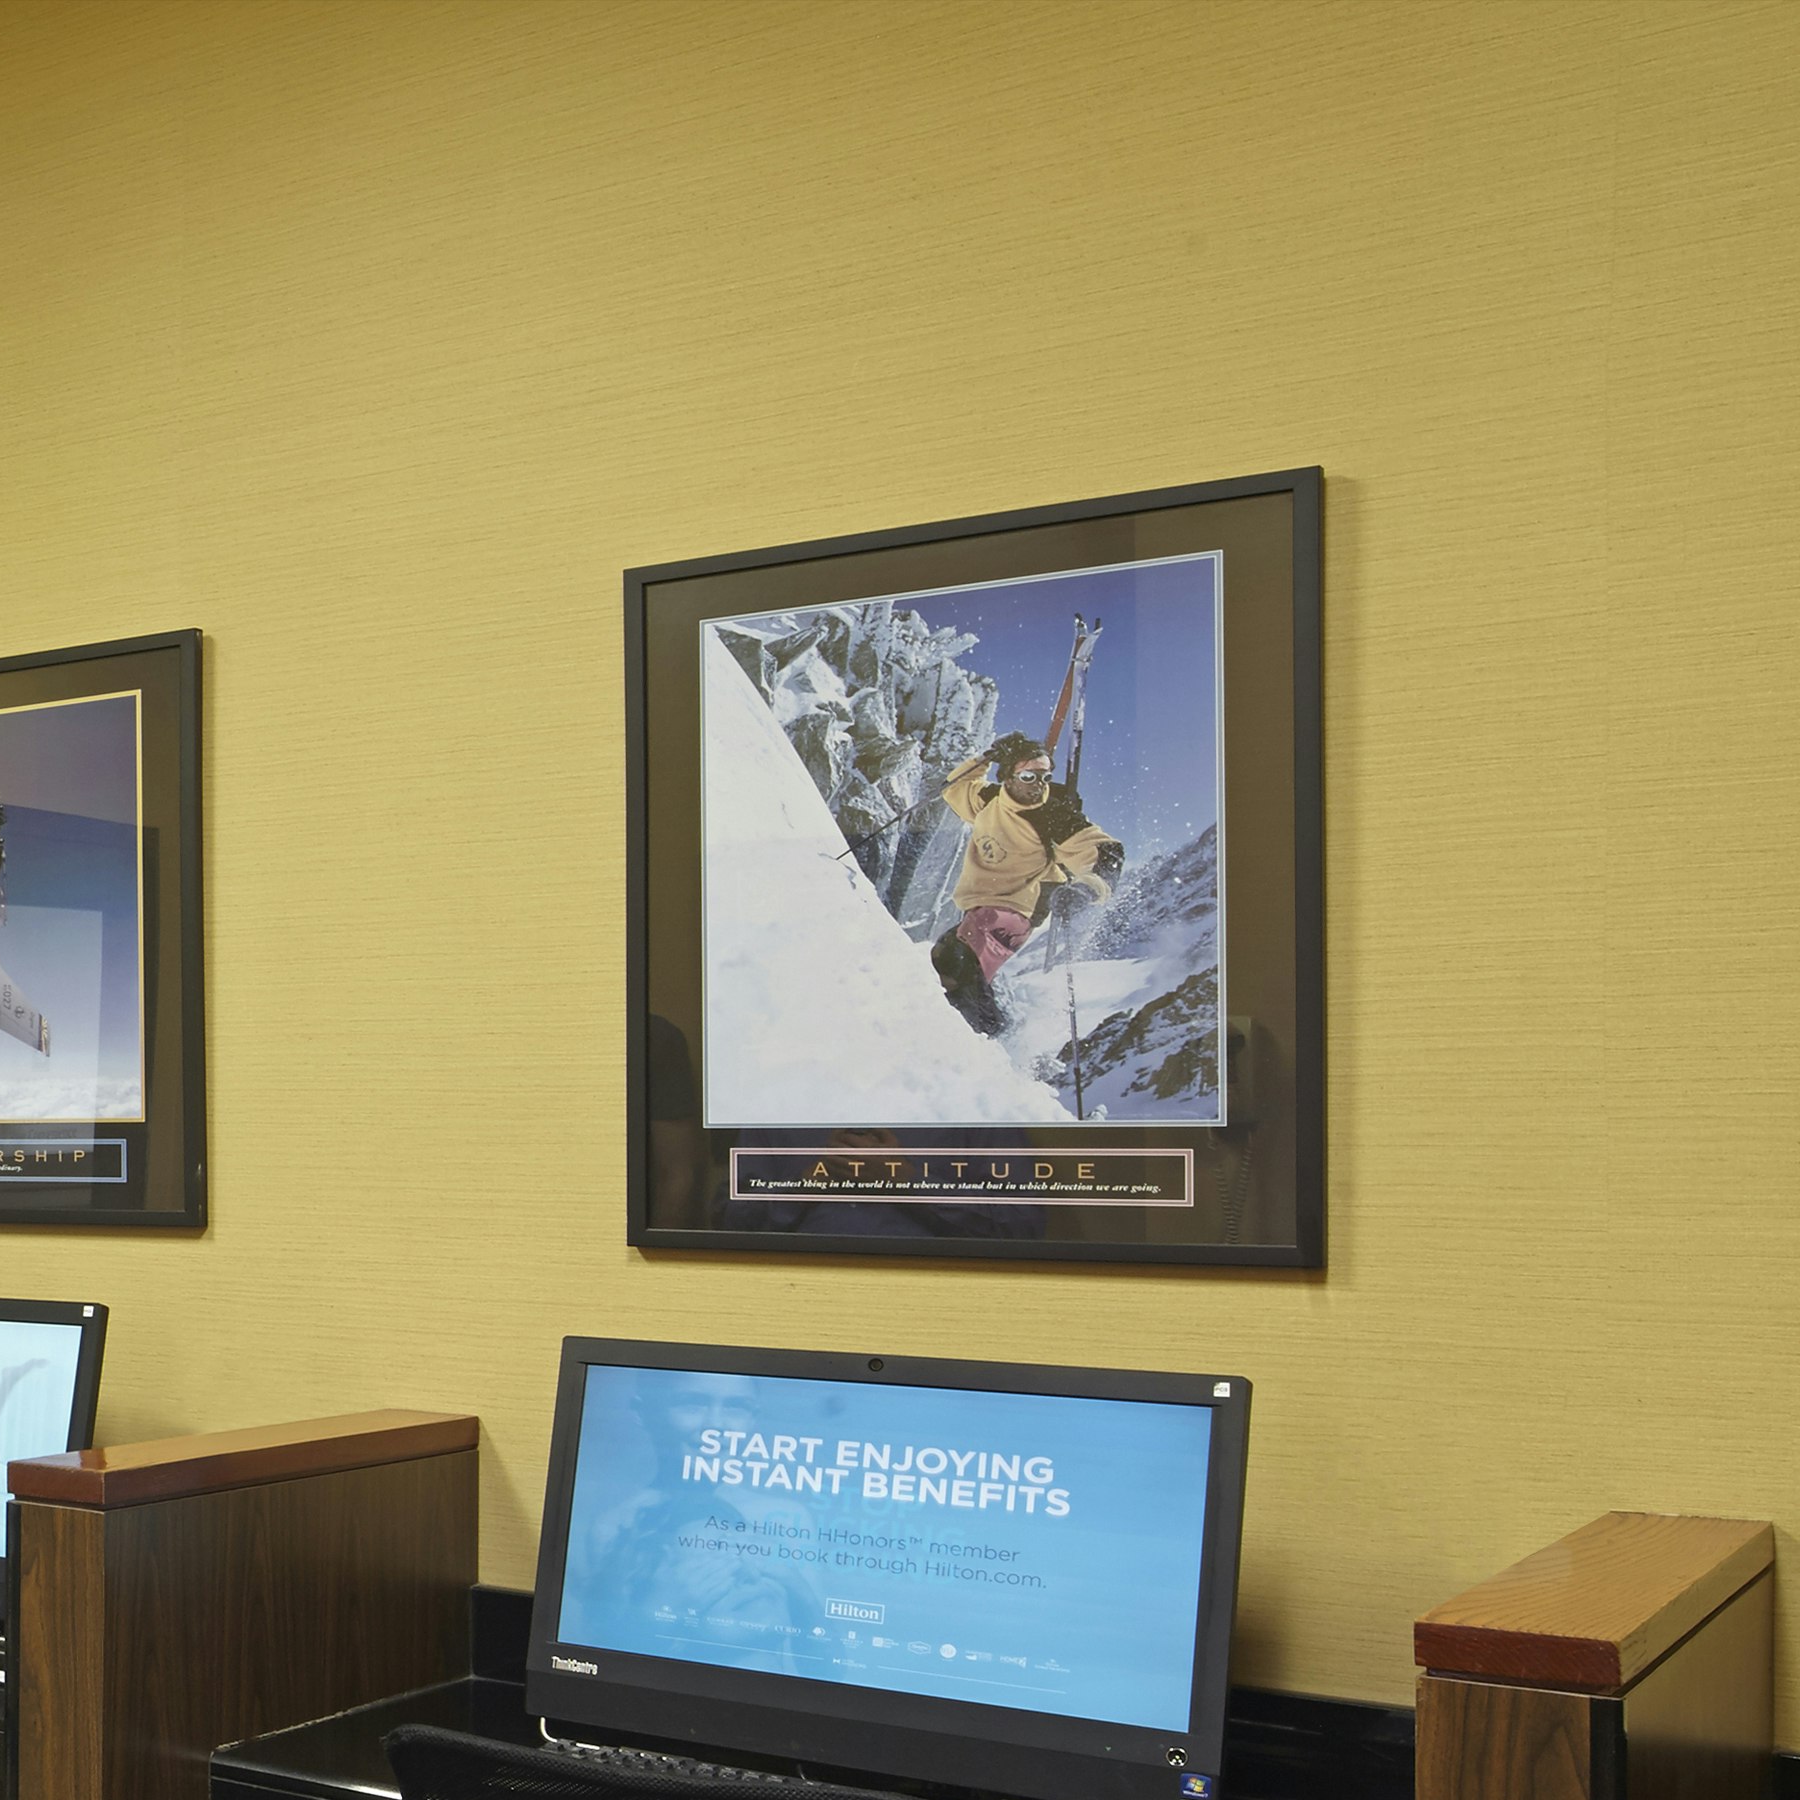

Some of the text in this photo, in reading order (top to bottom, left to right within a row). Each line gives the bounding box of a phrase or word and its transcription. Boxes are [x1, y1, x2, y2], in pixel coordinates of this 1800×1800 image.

[750, 1179, 766, 1188] The
[768, 1180, 801, 1190] greatest
[829, 1180, 839, 1188] in
[841, 1180, 856, 1188] the
[858, 1180, 884, 1189] world
[886, 1180, 894, 1189] is
[896, 1181, 911, 1189] not
[912, 1181, 941, 1190] where
[957, 1181, 984, 1190] stand
[986, 1181, 1002, 1190] but
[1005, 1181, 1016, 1190] in
[1019, 1181, 1048, 1191] which
[1050, 1181, 1093, 1191] direction
[1130, 1185, 1162, 1194] going.
[812, 1161, 1095, 1179] ATTITUDE
[699, 1429, 1054, 1485] START ENJOYING
[681, 1455, 1071, 1518] INSTANT BENEFITS
[704, 1515, 729, 1532] As
[735, 1521, 747, 1533] a
[752, 1520, 810, 1541] Hilton
[929, 1539, 1020, 1563] member
[678, 1533, 728, 1551] when
[735, 1541, 771, 1559] you
[778, 1543, 828, 1565] book
[835, 1549, 918, 1576] through
[924, 1560, 1047, 1589] Hilton.com.
[830, 1602, 879, 1621] Hilton
[551, 1655, 599, 1676] ThinkCentre
